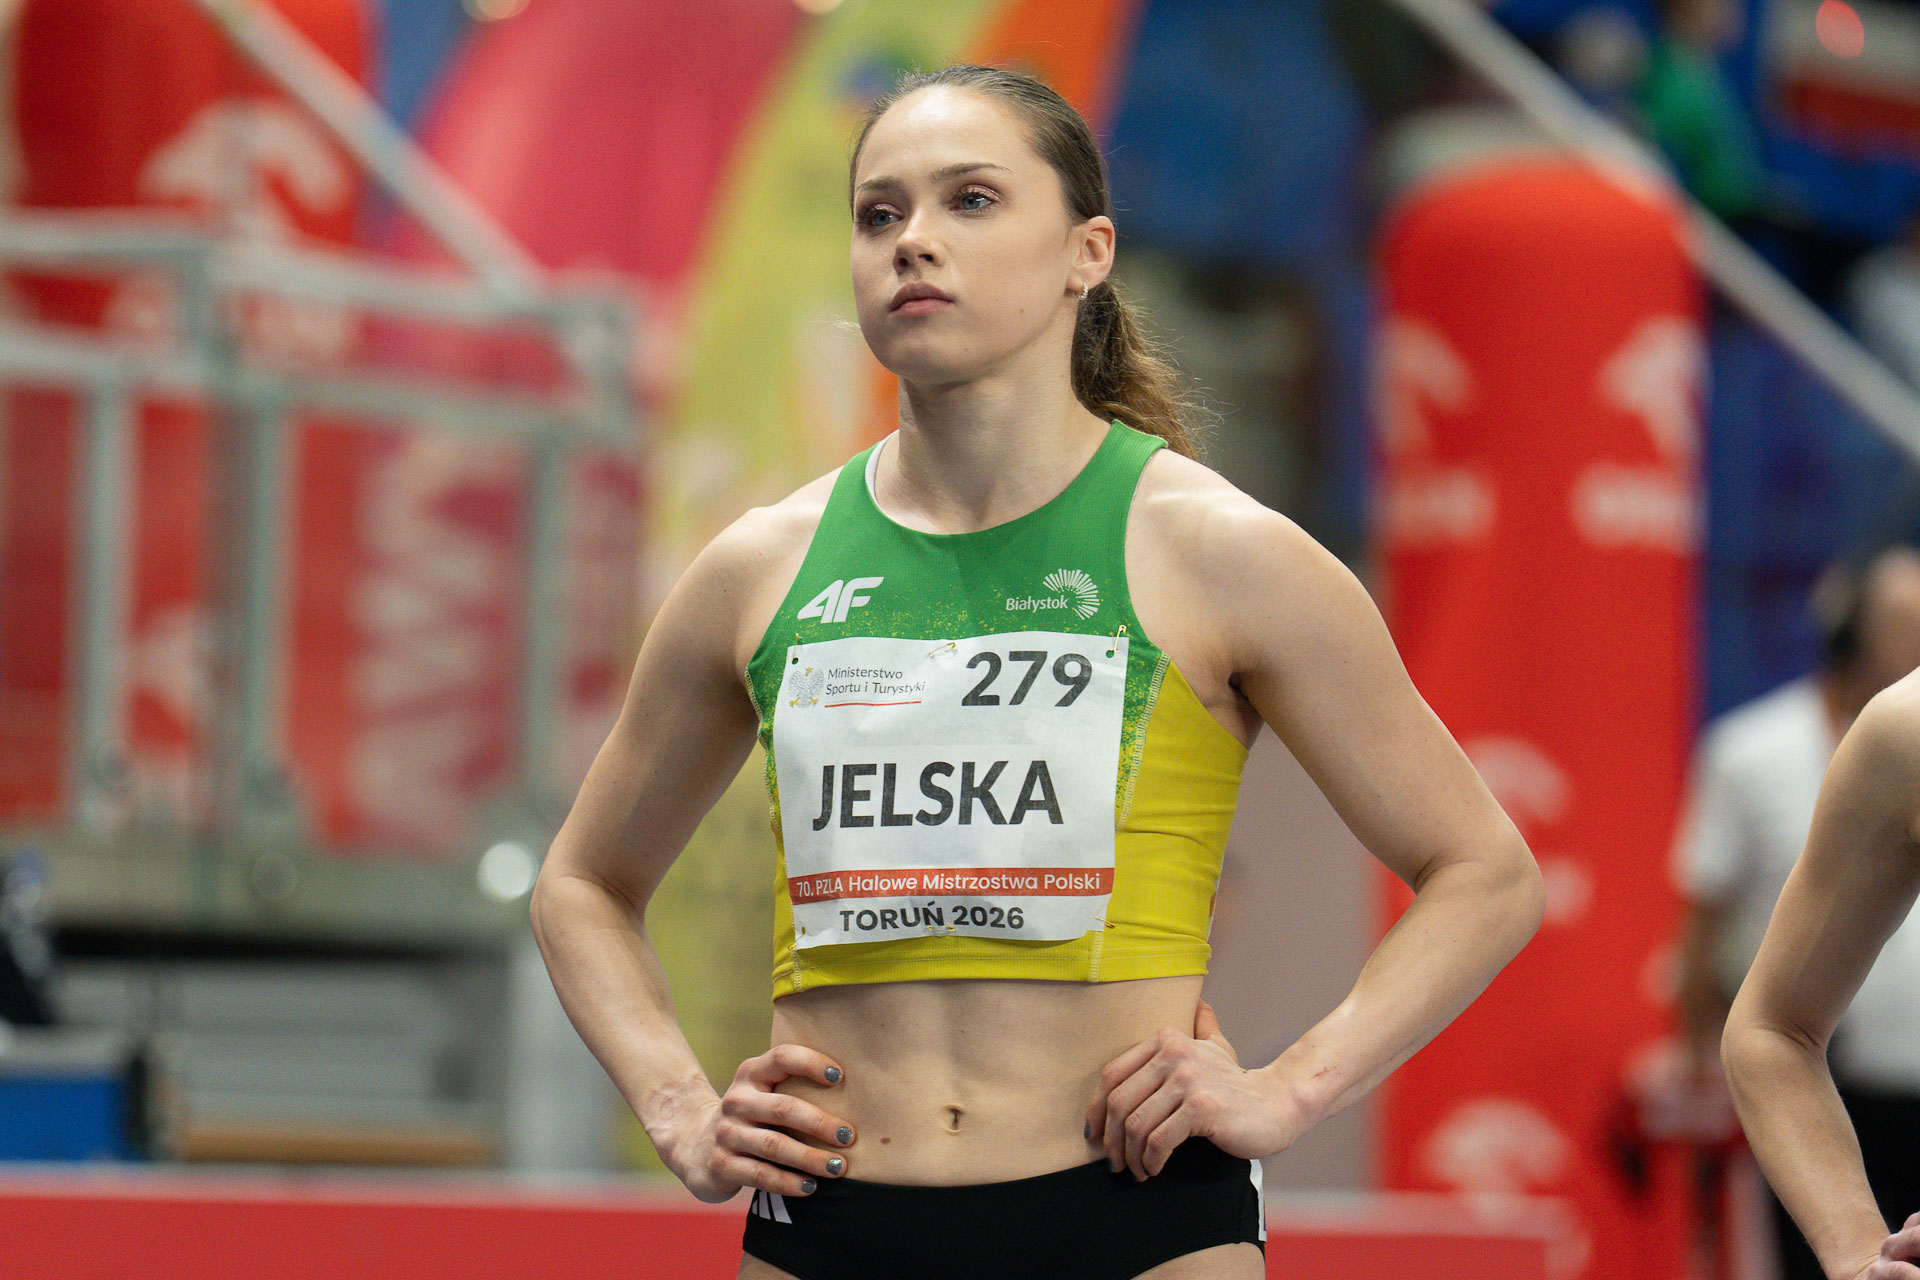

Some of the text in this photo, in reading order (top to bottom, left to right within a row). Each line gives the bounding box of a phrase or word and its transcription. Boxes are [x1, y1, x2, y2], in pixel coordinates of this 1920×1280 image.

[1006, 596, 1068, 613] Białystok
[828, 667, 903, 680] Ministerstwo
[961, 650, 1093, 707] 279
[826, 682, 925, 696] Sportu i Turystyki
[813, 760, 1064, 831] JELSKA
[797, 872, 1100, 897] 70. PZLA Halowe Mistrzostwa Polski
[840, 901, 1024, 932] TORUŃ 2026
